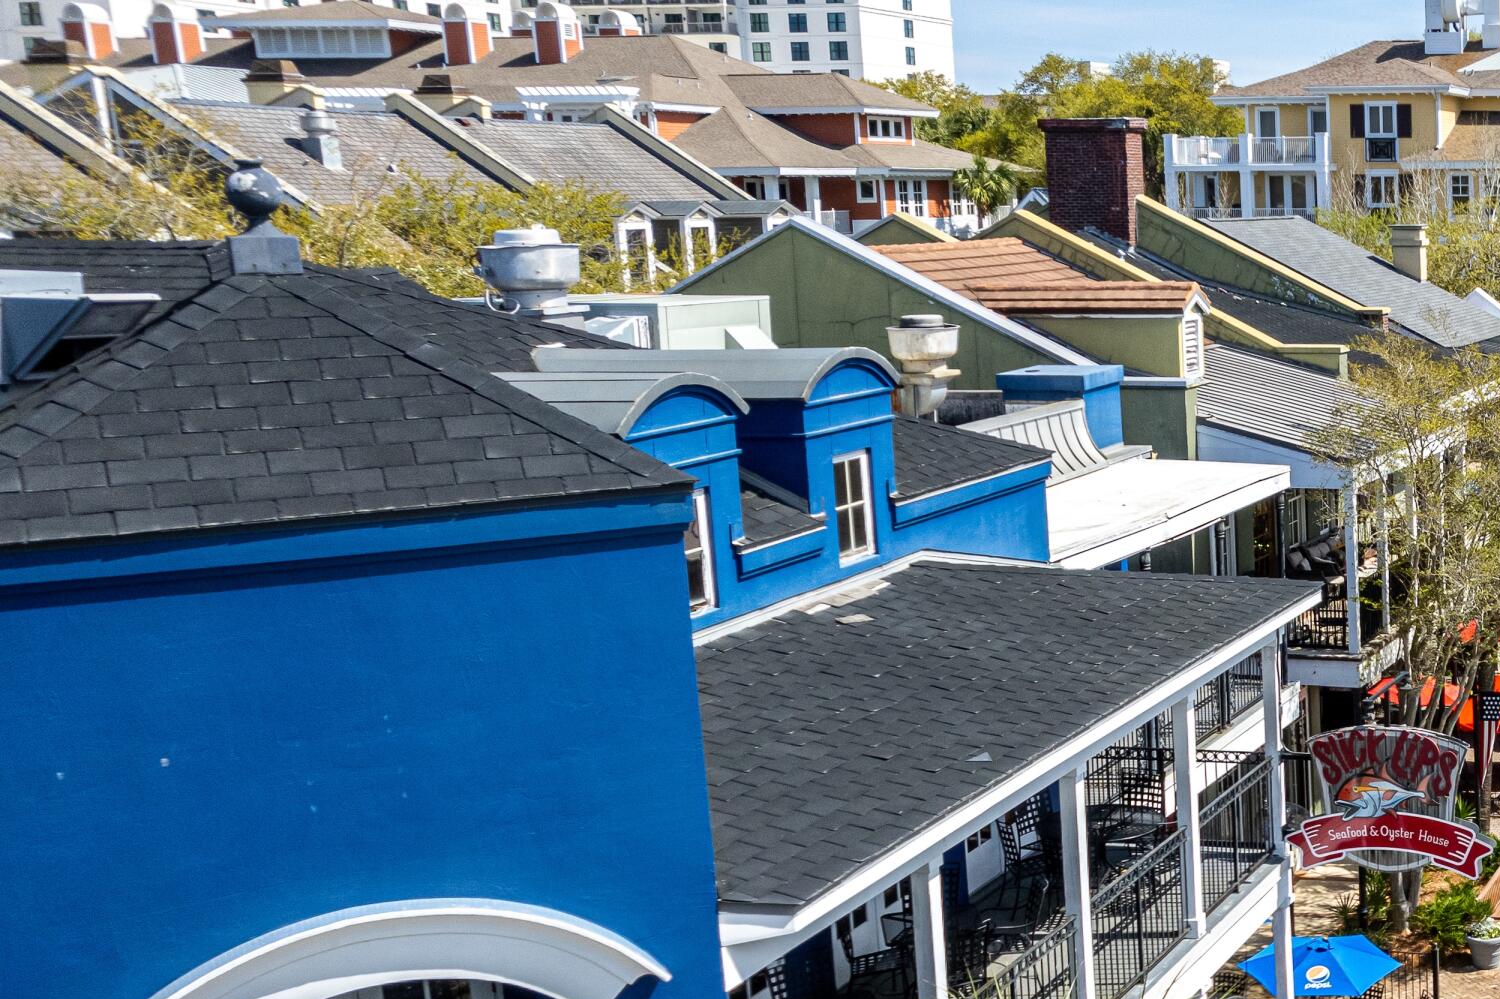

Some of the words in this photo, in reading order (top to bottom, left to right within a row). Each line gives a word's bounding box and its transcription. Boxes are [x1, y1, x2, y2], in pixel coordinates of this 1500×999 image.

[1328, 825, 1367, 841] Seafood
[1369, 826, 1380, 837] &
[1380, 825, 1415, 842] Oyster
[1418, 829, 1450, 847] House
